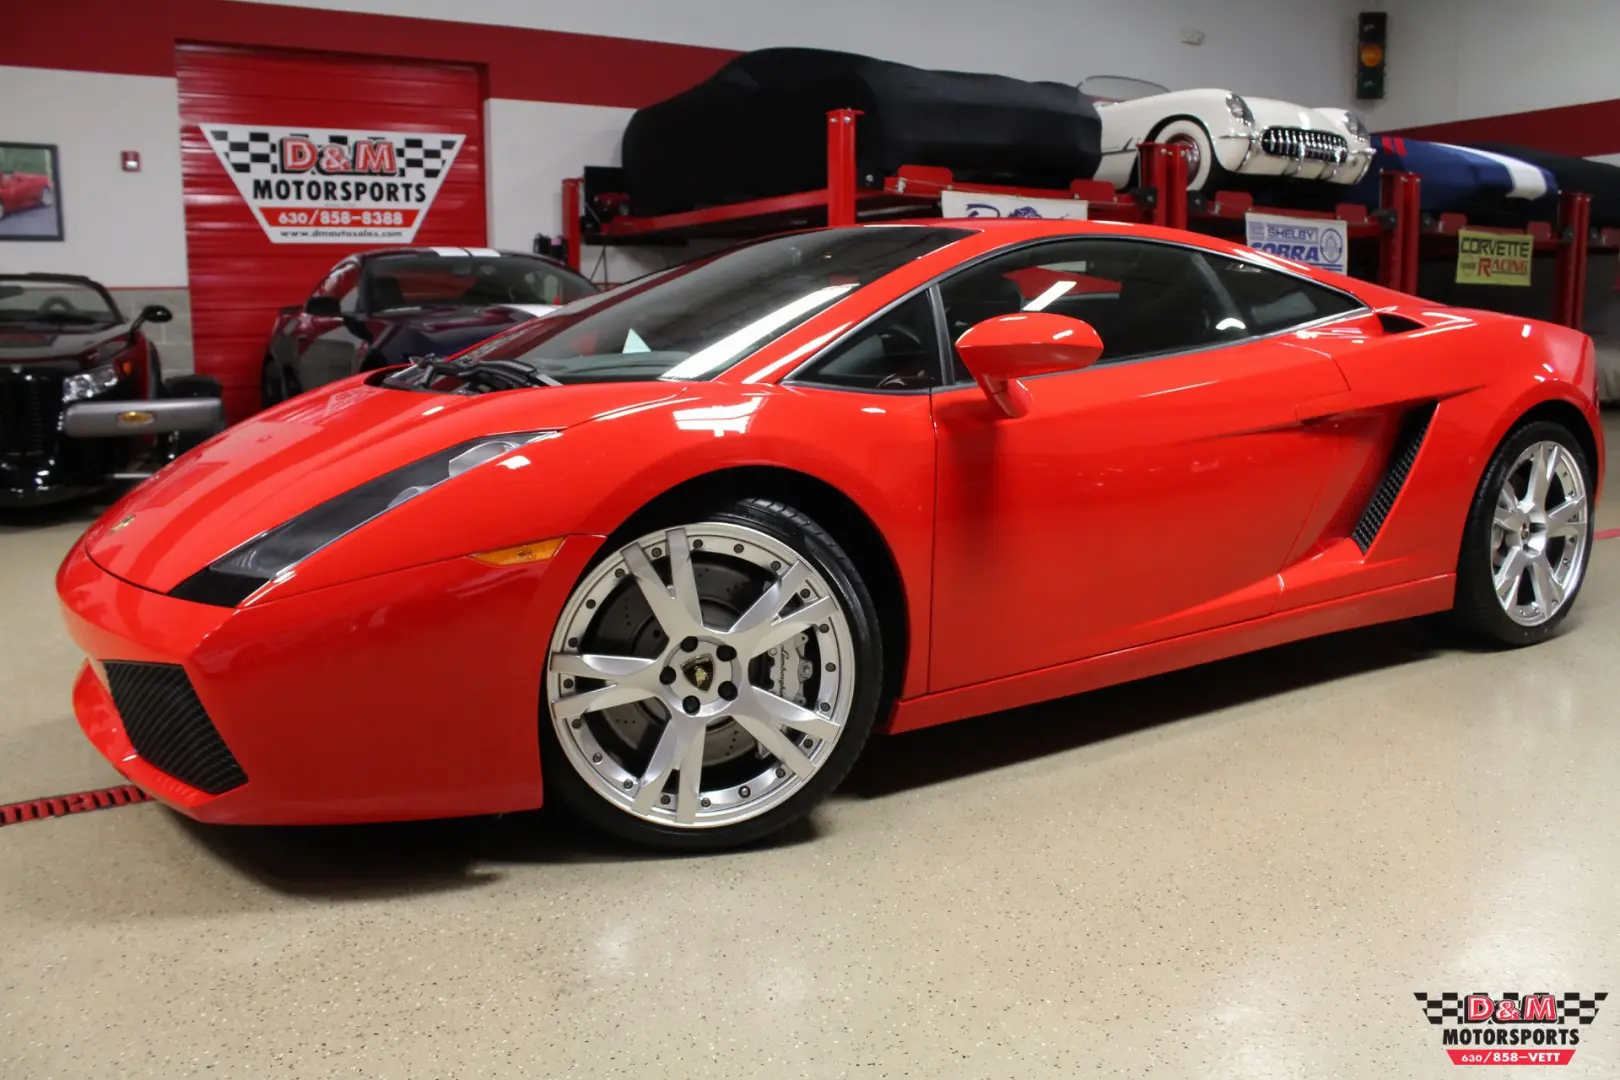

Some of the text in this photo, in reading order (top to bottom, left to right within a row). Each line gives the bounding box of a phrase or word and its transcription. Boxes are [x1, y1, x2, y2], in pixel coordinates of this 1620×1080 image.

[280, 137, 397, 175] D&M
[253, 179, 426, 203] MOTORSPORTS
[278, 209, 403, 225] 630/858-8388
[1268, 227, 1314, 240] SHELBY
[1461, 237, 1530, 257] CORVETTE
[1477, 258, 1527, 277] RACING
